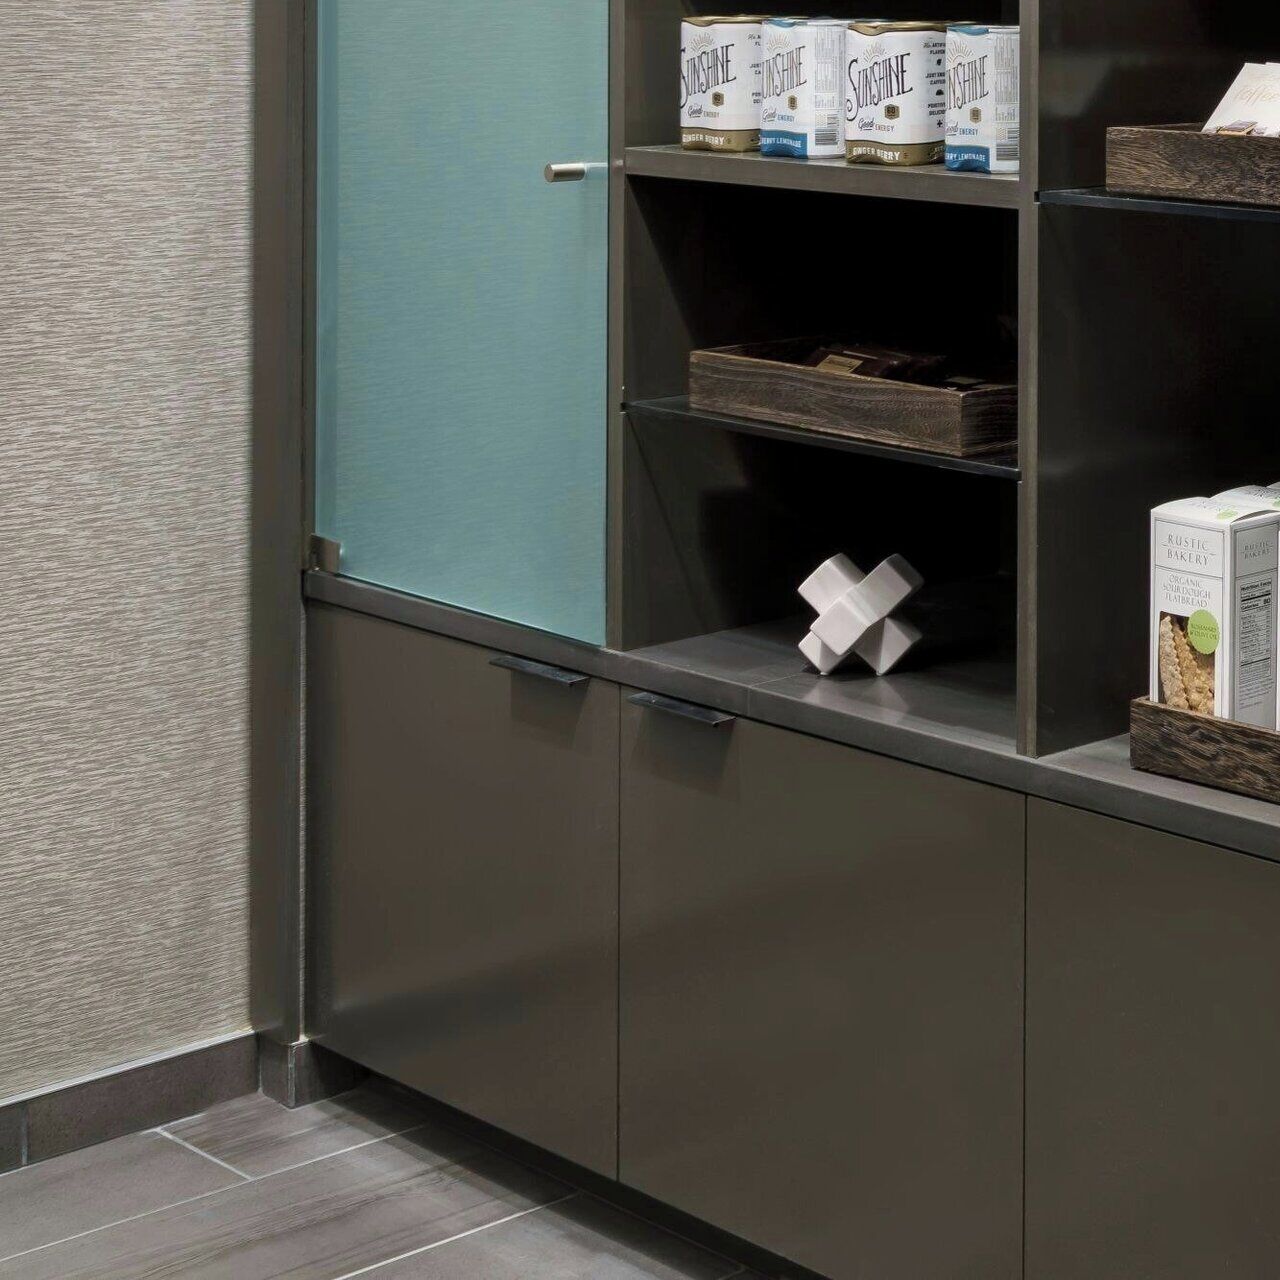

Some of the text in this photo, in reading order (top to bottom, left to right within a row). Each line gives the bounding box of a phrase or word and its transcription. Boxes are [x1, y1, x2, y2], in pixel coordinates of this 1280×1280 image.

[761, 46, 807, 99] UNSHINE
[847, 53, 913, 121] SUNSHINE
[946, 55, 989, 111] NSHINE
[1167, 534, 1209, 552] RUSTIC
[1167, 549, 1209, 566] BAKERY
[1169, 574, 1204, 588] ORGANIC
[1163, 584, 1211, 601] SOURDOUGH
[1164, 592, 1208, 608] FLATBREAD
